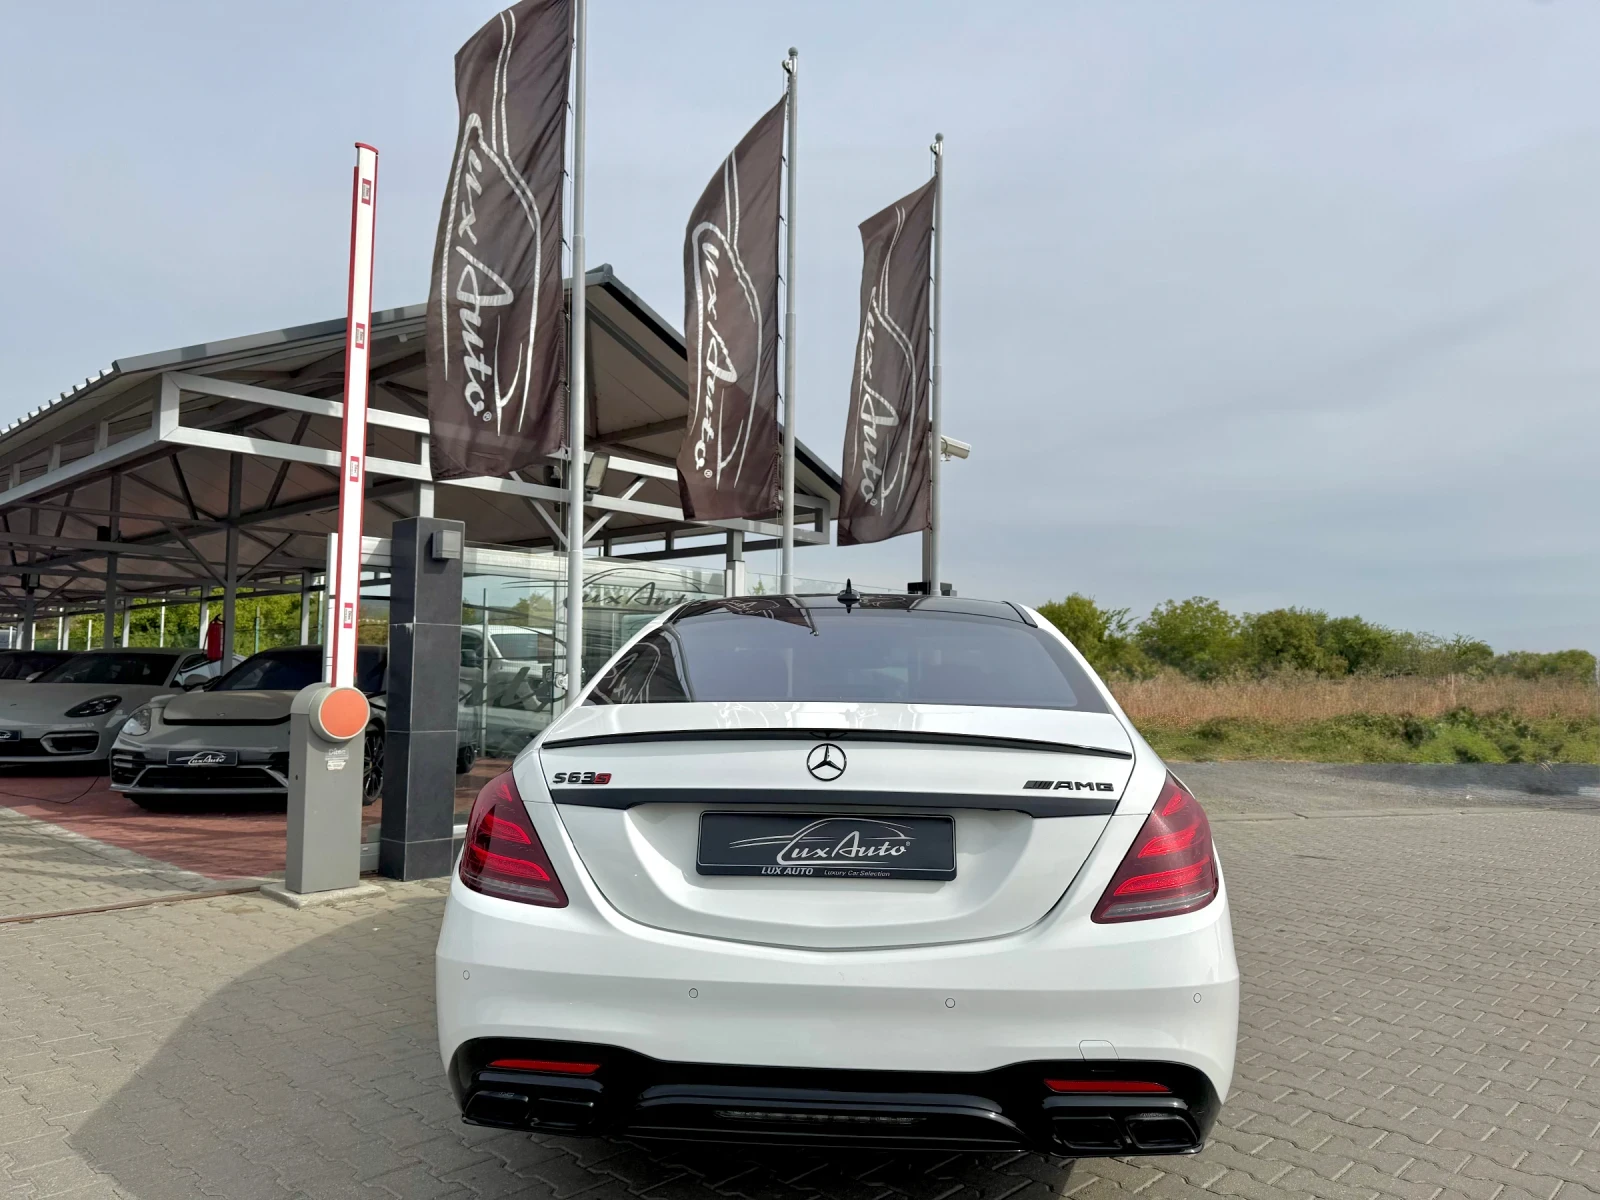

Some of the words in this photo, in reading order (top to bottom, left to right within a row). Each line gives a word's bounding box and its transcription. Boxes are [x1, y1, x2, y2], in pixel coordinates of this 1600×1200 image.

[455, 246, 514, 416] Auto
[694, 321, 738, 470] Auto
[860, 380, 899, 503] Auto
[626, 581, 698, 606] Aut
[1052, 780, 1114, 792] AMG
[776, 837, 831, 866] Lux
[831, 830, 909, 858] Auto
[761, 866, 782, 875] LUX
[783, 867, 814, 876] AUTO
[823, 869, 847, 877] Luxury
[859, 870, 891, 878] Selection
